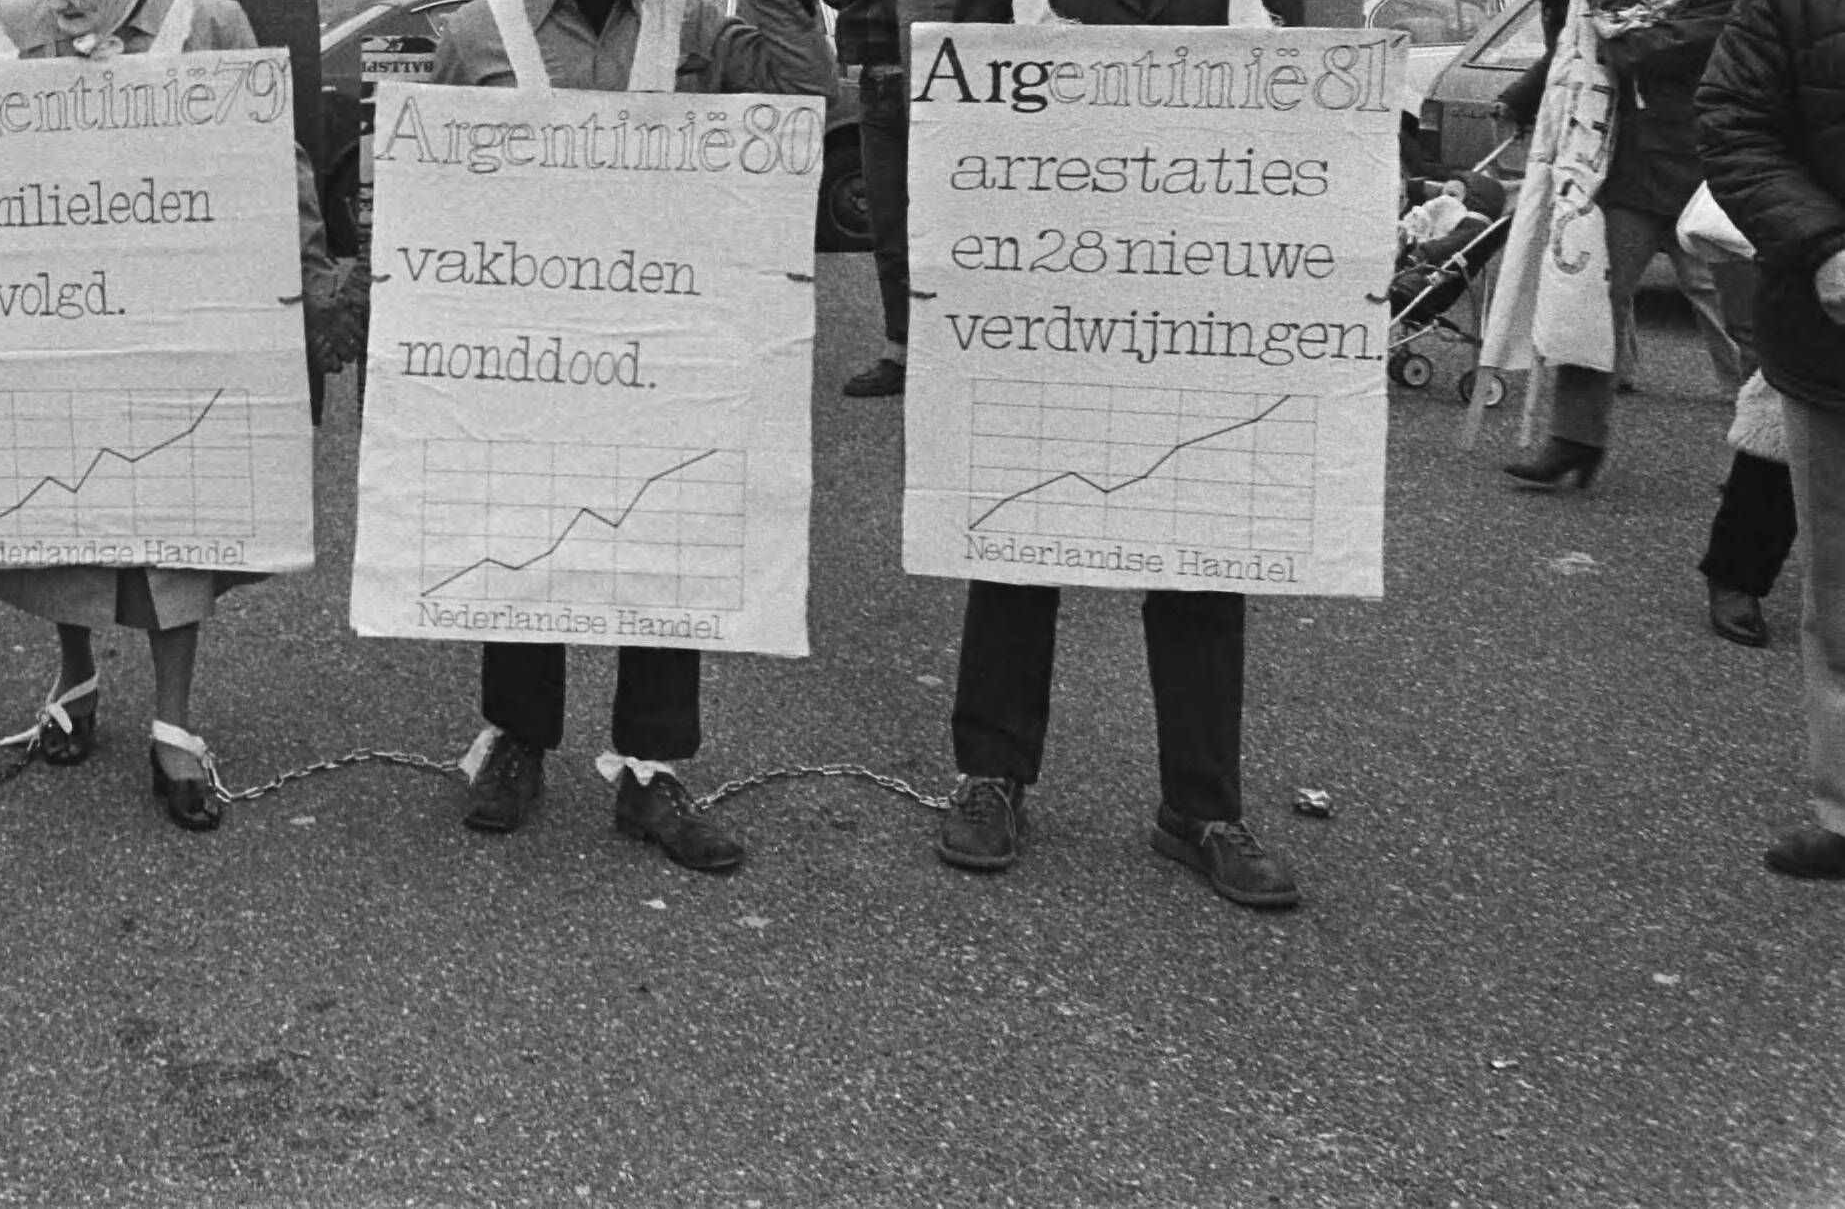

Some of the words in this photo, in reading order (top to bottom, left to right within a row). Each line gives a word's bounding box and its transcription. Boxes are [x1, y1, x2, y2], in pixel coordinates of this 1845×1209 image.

[950, 147, 1330, 196] arrestaties
[396, 241, 702, 296] vakbonden
[944, 305, 1385, 366] verdwijningen.
[398, 337, 658, 390] monddood.
[144, 541, 246, 566] Handel
[962, 535, 1165, 574] Nederlandse
[1175, 550, 1300, 584] Handel
[416, 602, 608, 635] Nederlandse
[616, 611, 724, 641] Handel
